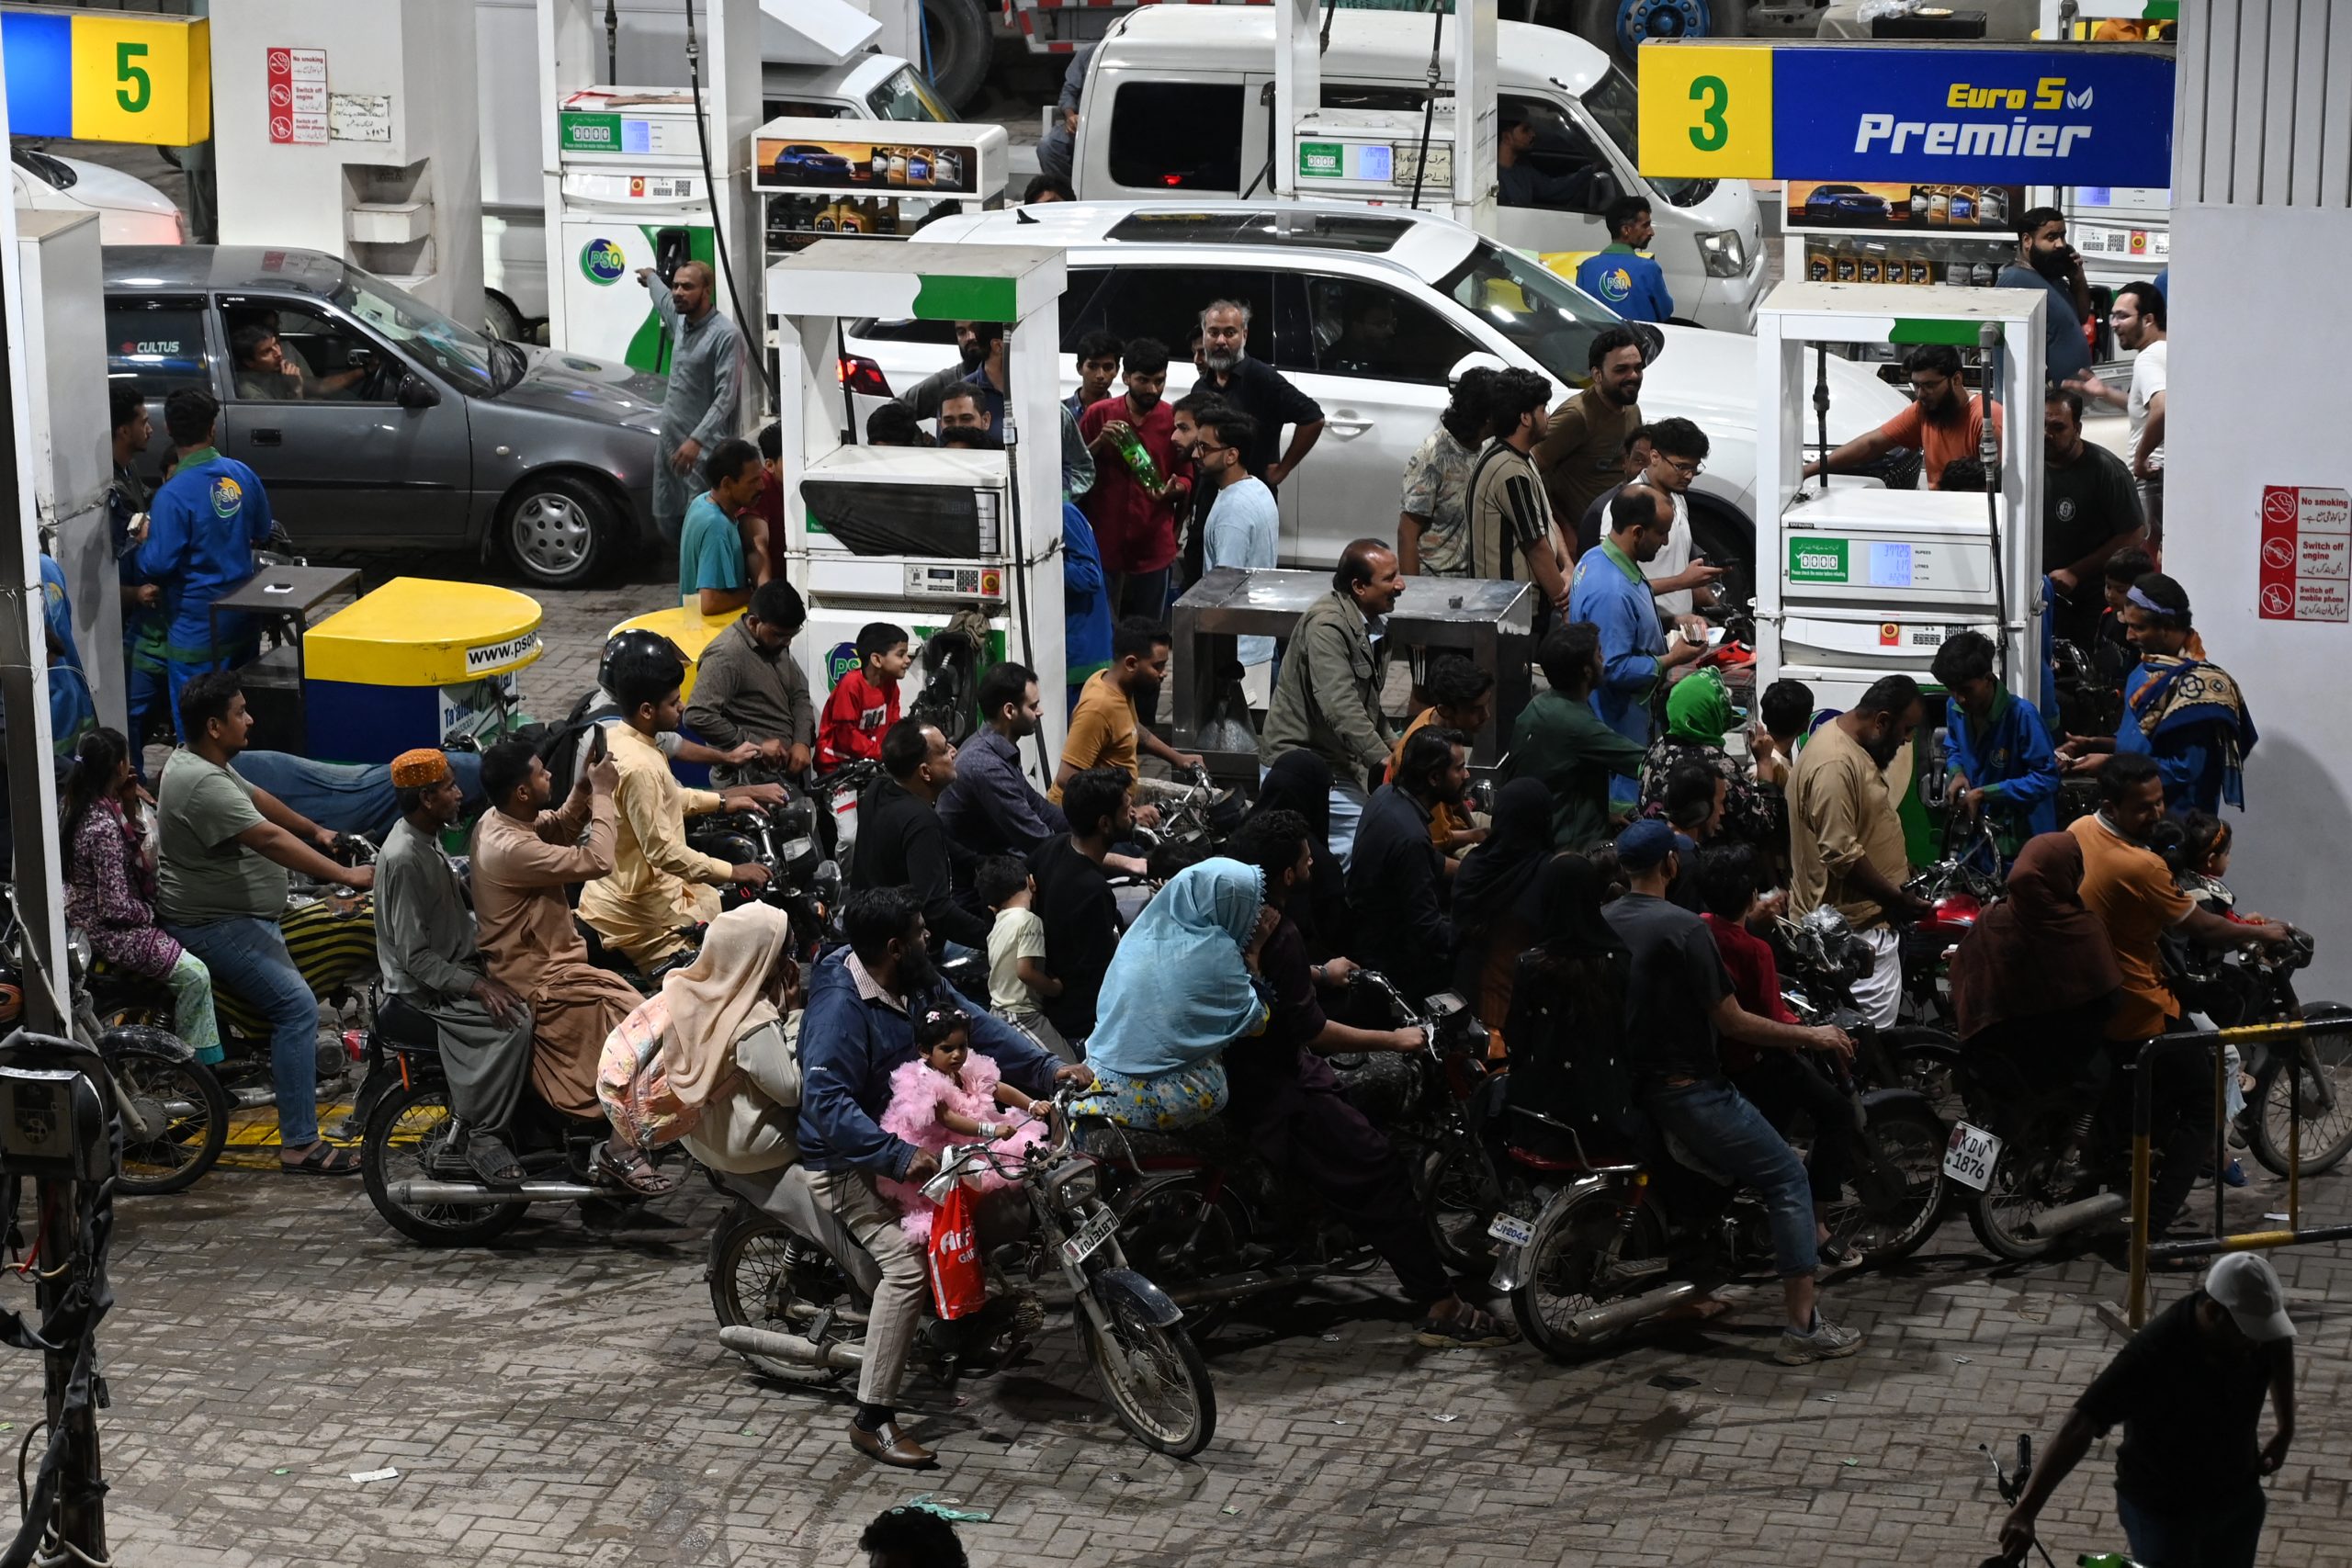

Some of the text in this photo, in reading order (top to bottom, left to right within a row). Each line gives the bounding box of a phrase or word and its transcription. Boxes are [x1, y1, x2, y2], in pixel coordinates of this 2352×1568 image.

[116, 42, 151, 112] 5
[1947, 77, 2067, 109] Euro 5
[1689, 75, 1728, 152] 3
[1854, 113, 2092, 157] Premier
[590, 250, 622, 271] PSO
[1607, 276, 1628, 290] PSO
[137, 341, 179, 353] CULTUS
[214, 486, 237, 507] PSO
[2301, 497, 2348, 509] No smoking
[2302, 541, 2344, 551] Switch off
[2302, 551, 2330, 561] engine
[2324, 595, 2345, 604] phone
[833, 658, 862, 680] PS
[1960, 1135, 1987, 1157] KDV
[1952, 1152, 1985, 1179] 1876
